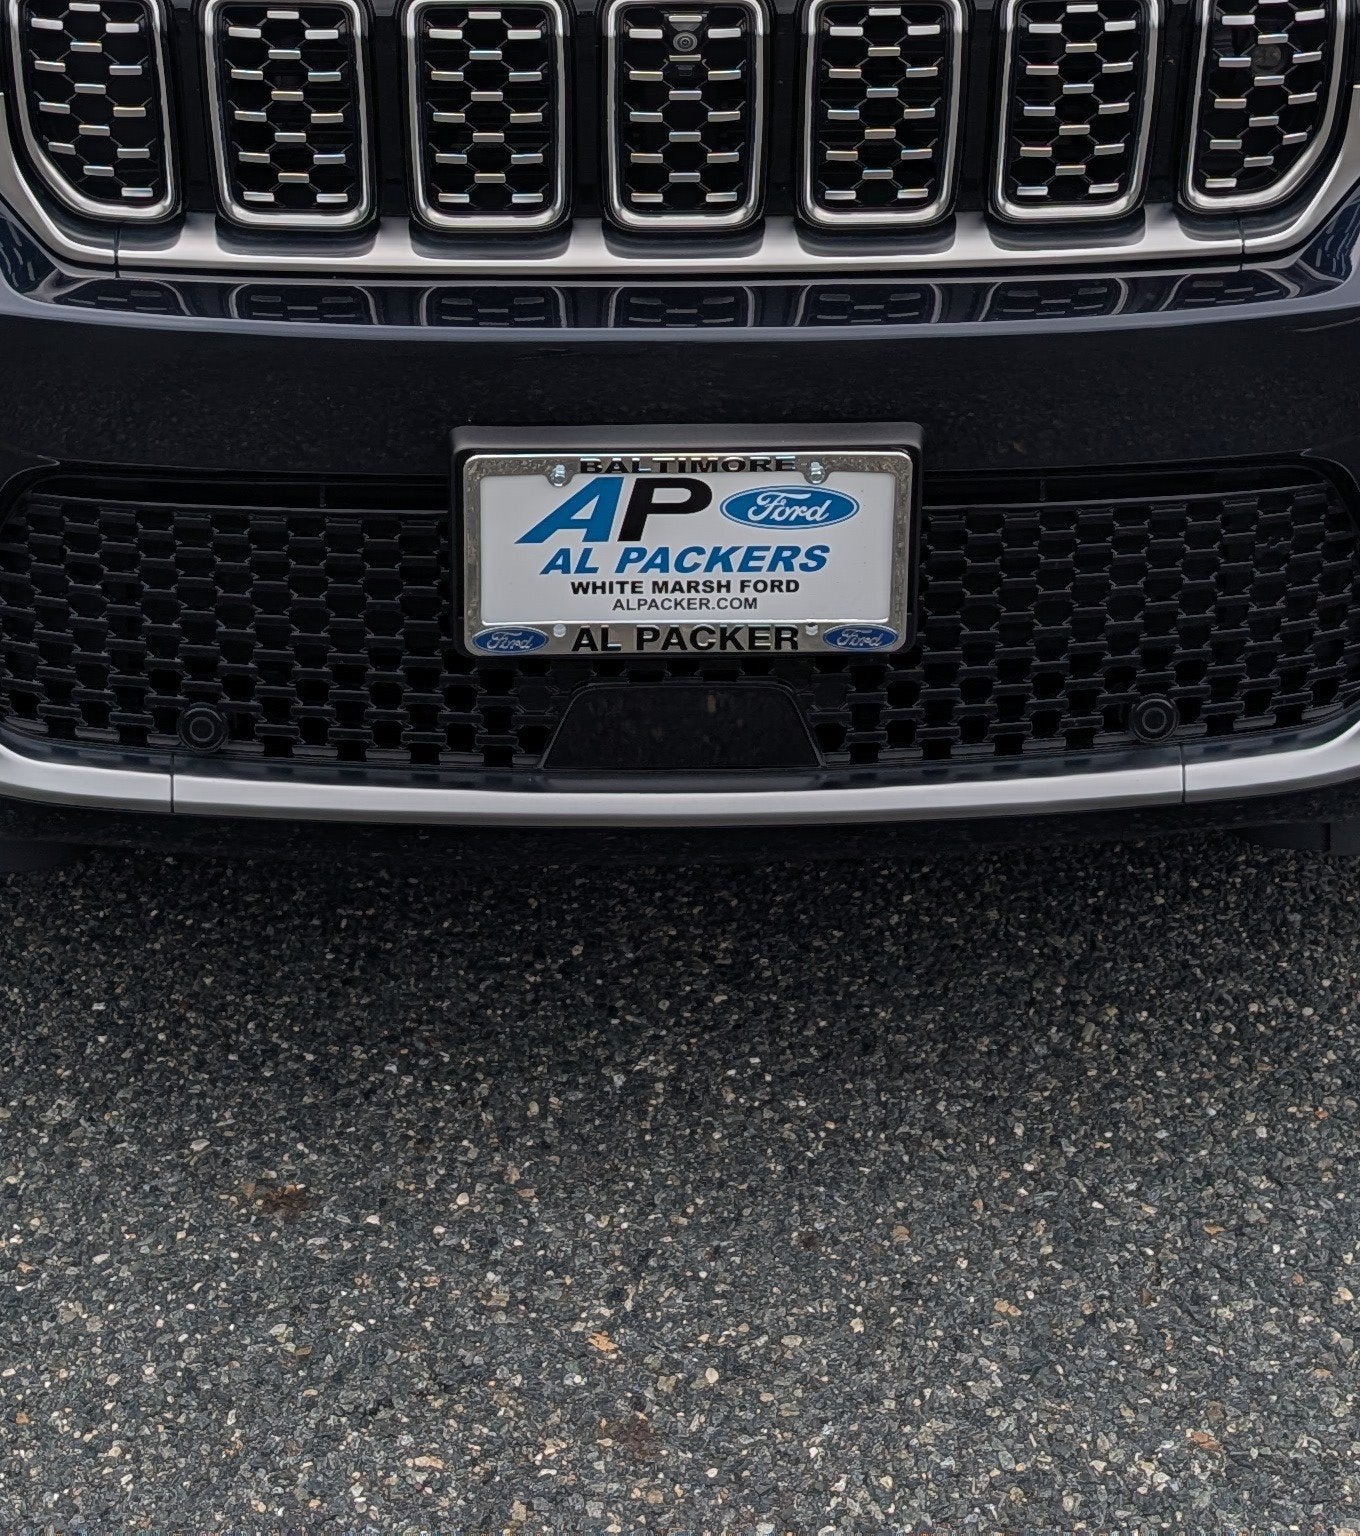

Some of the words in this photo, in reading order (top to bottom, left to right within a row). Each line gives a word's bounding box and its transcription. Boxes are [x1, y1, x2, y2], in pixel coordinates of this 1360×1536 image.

[579, 456, 797, 474] BALTIMORE
[514, 476, 713, 544] AP
[746, 491, 833, 522] Ford
[539, 547, 600, 575] AL
[614, 544, 831, 575] PACKERS
[570, 580, 644, 595] WHITE
[651, 579, 732, 595] MARSH
[739, 579, 801, 594] FORD
[611, 596, 759, 612] ALPACKER.COM
[486, 630, 534, 651] Ford
[571, 624, 623, 653] AL
[636, 623, 800, 653] PACKER
[836, 627, 884, 648] Ford
